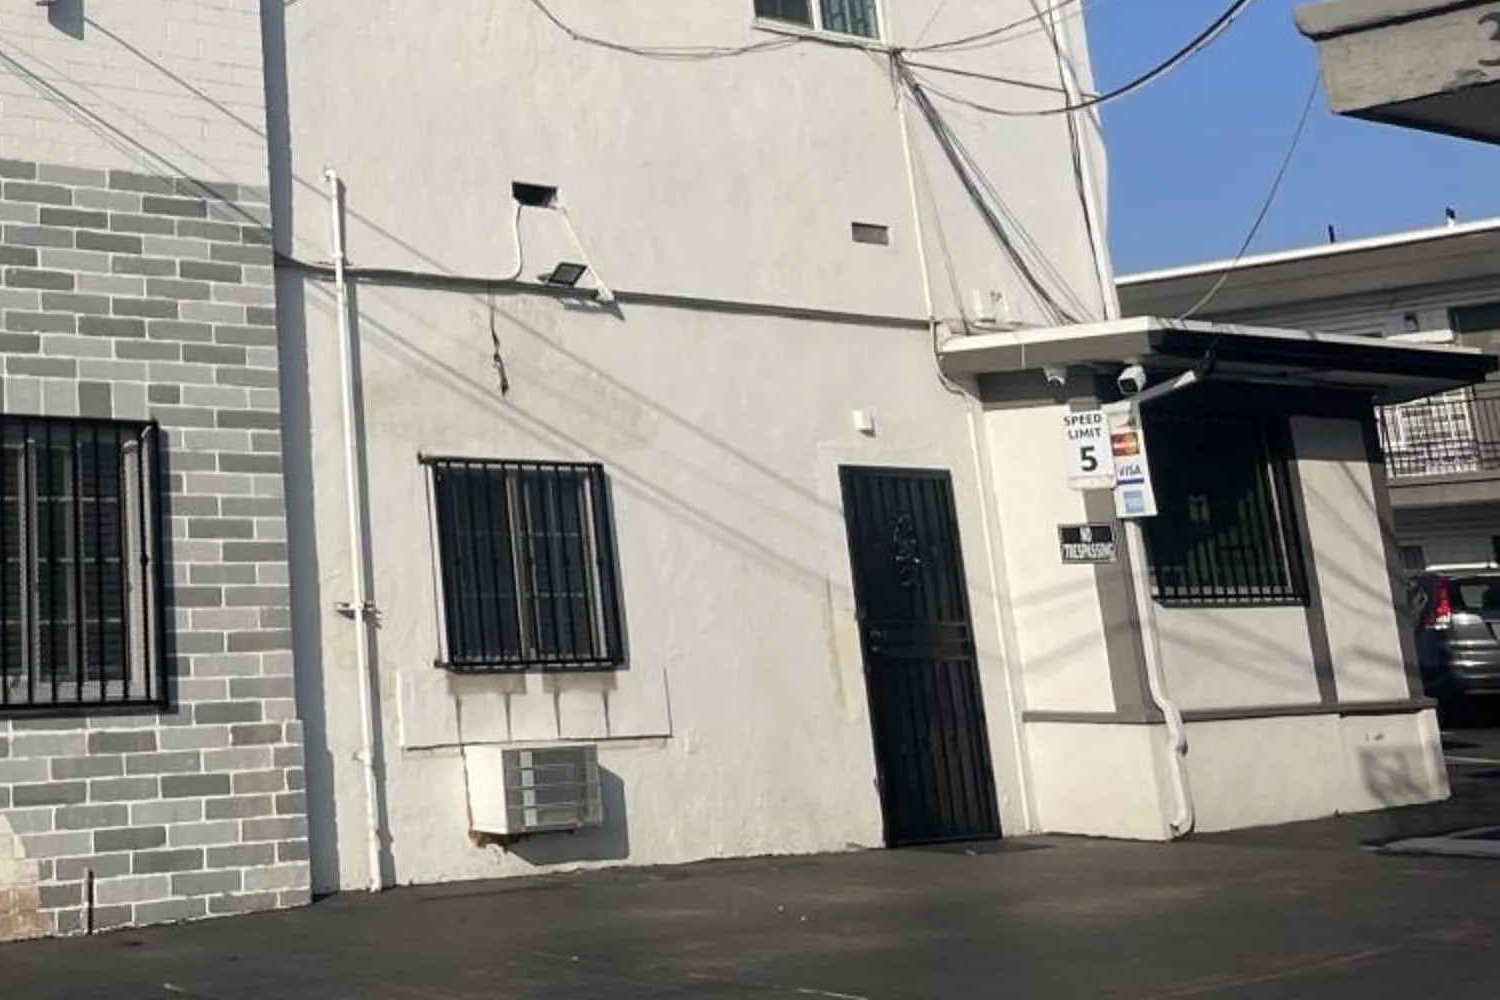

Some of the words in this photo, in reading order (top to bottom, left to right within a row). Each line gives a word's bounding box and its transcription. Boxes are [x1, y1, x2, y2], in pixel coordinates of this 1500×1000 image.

[1063, 413, 1102, 426] SPEED
[1067, 427, 1102, 440] LIMIT
[1080, 445, 1098, 472] 5
[1119, 464, 1143, 477] VISA
